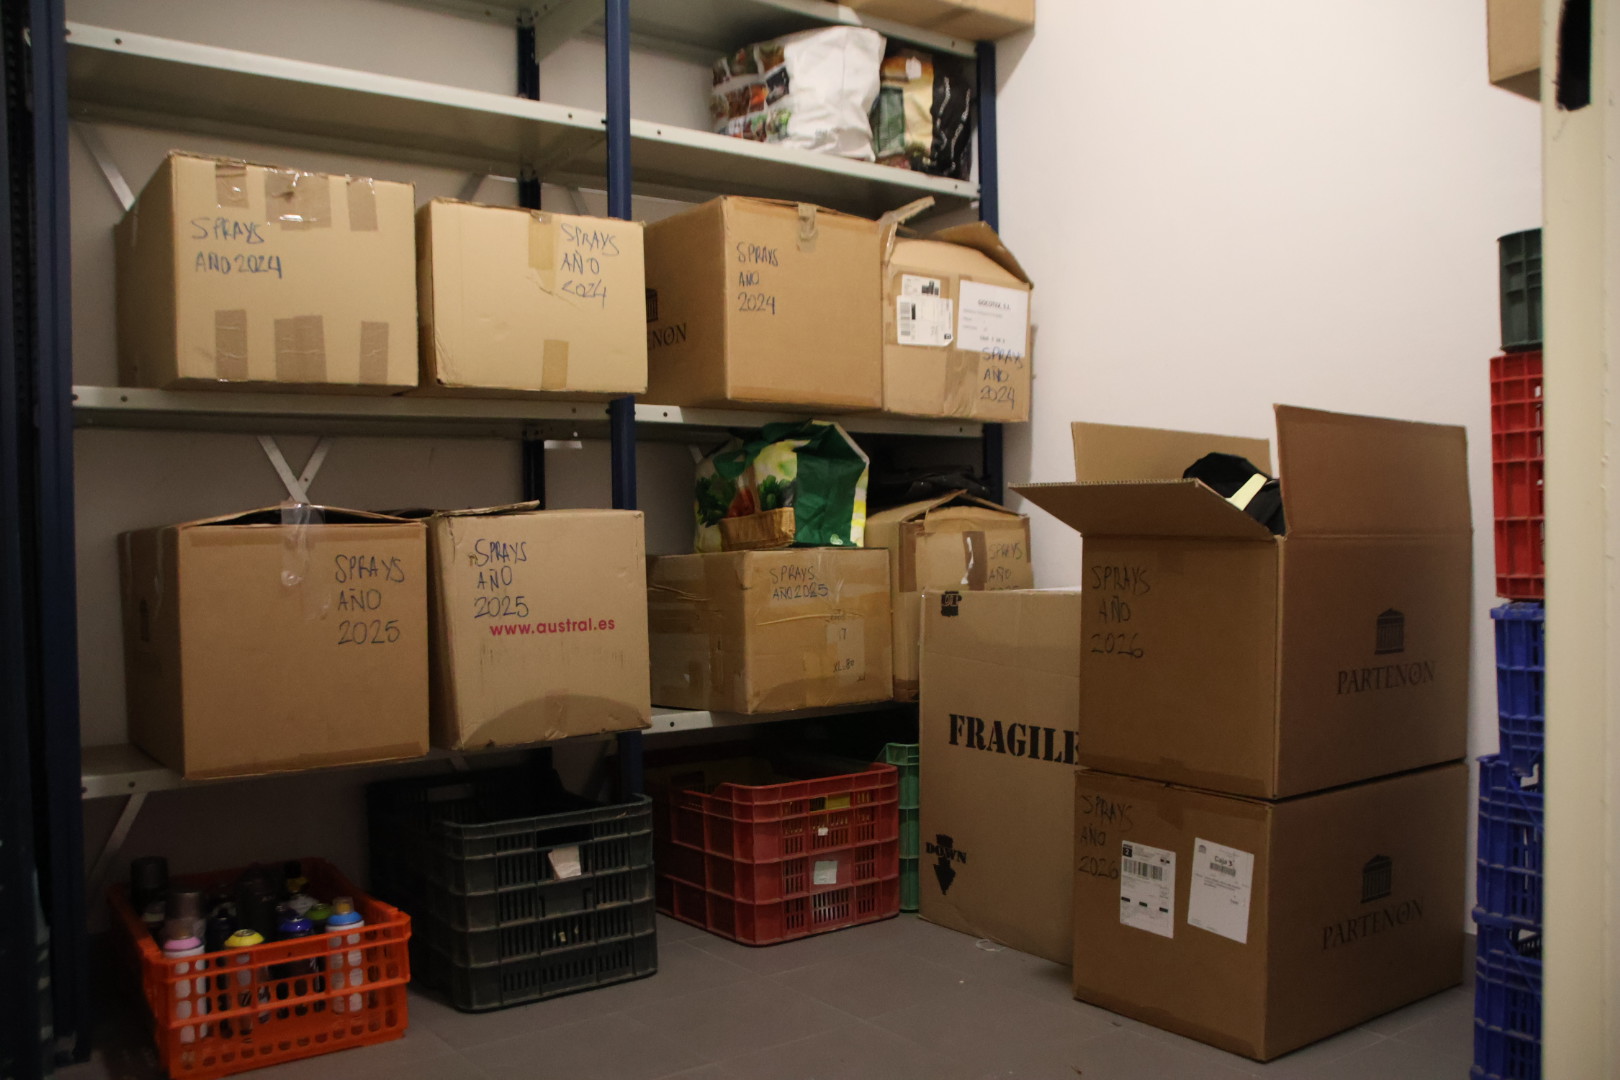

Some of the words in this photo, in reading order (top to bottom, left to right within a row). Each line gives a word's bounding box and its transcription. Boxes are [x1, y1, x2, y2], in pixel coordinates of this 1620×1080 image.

[190, 216, 265, 245] SPRAYS
[560, 222, 620, 257] SPRAYS
[736, 241, 779, 267] SPRAYS
[737, 291, 776, 316] 2024
[980, 384, 1016, 410] 2024
[474, 538, 528, 567] SPRAYS
[335, 554, 405, 583] SPRAYS
[477, 565, 513, 591] AÑO
[769, 563, 816, 585] SPRAYS
[1091, 565, 1151, 595] SPRAYS
[337, 588, 382, 612] AÑO
[474, 595, 529, 619] 2025
[338, 619, 401, 645] 2025
[489, 617, 616, 637] www.austral.es
[1090, 632, 1144, 659] 2026
[1336, 660, 1437, 695] PARTENON
[948, 713, 1079, 766] FRAGILE
[1080, 794, 1134, 832] SPRAYS
[925, 841, 967, 864] DOWN
[1078, 855, 1120, 880] 2026
[1321, 895, 1424, 952] PARTENON
